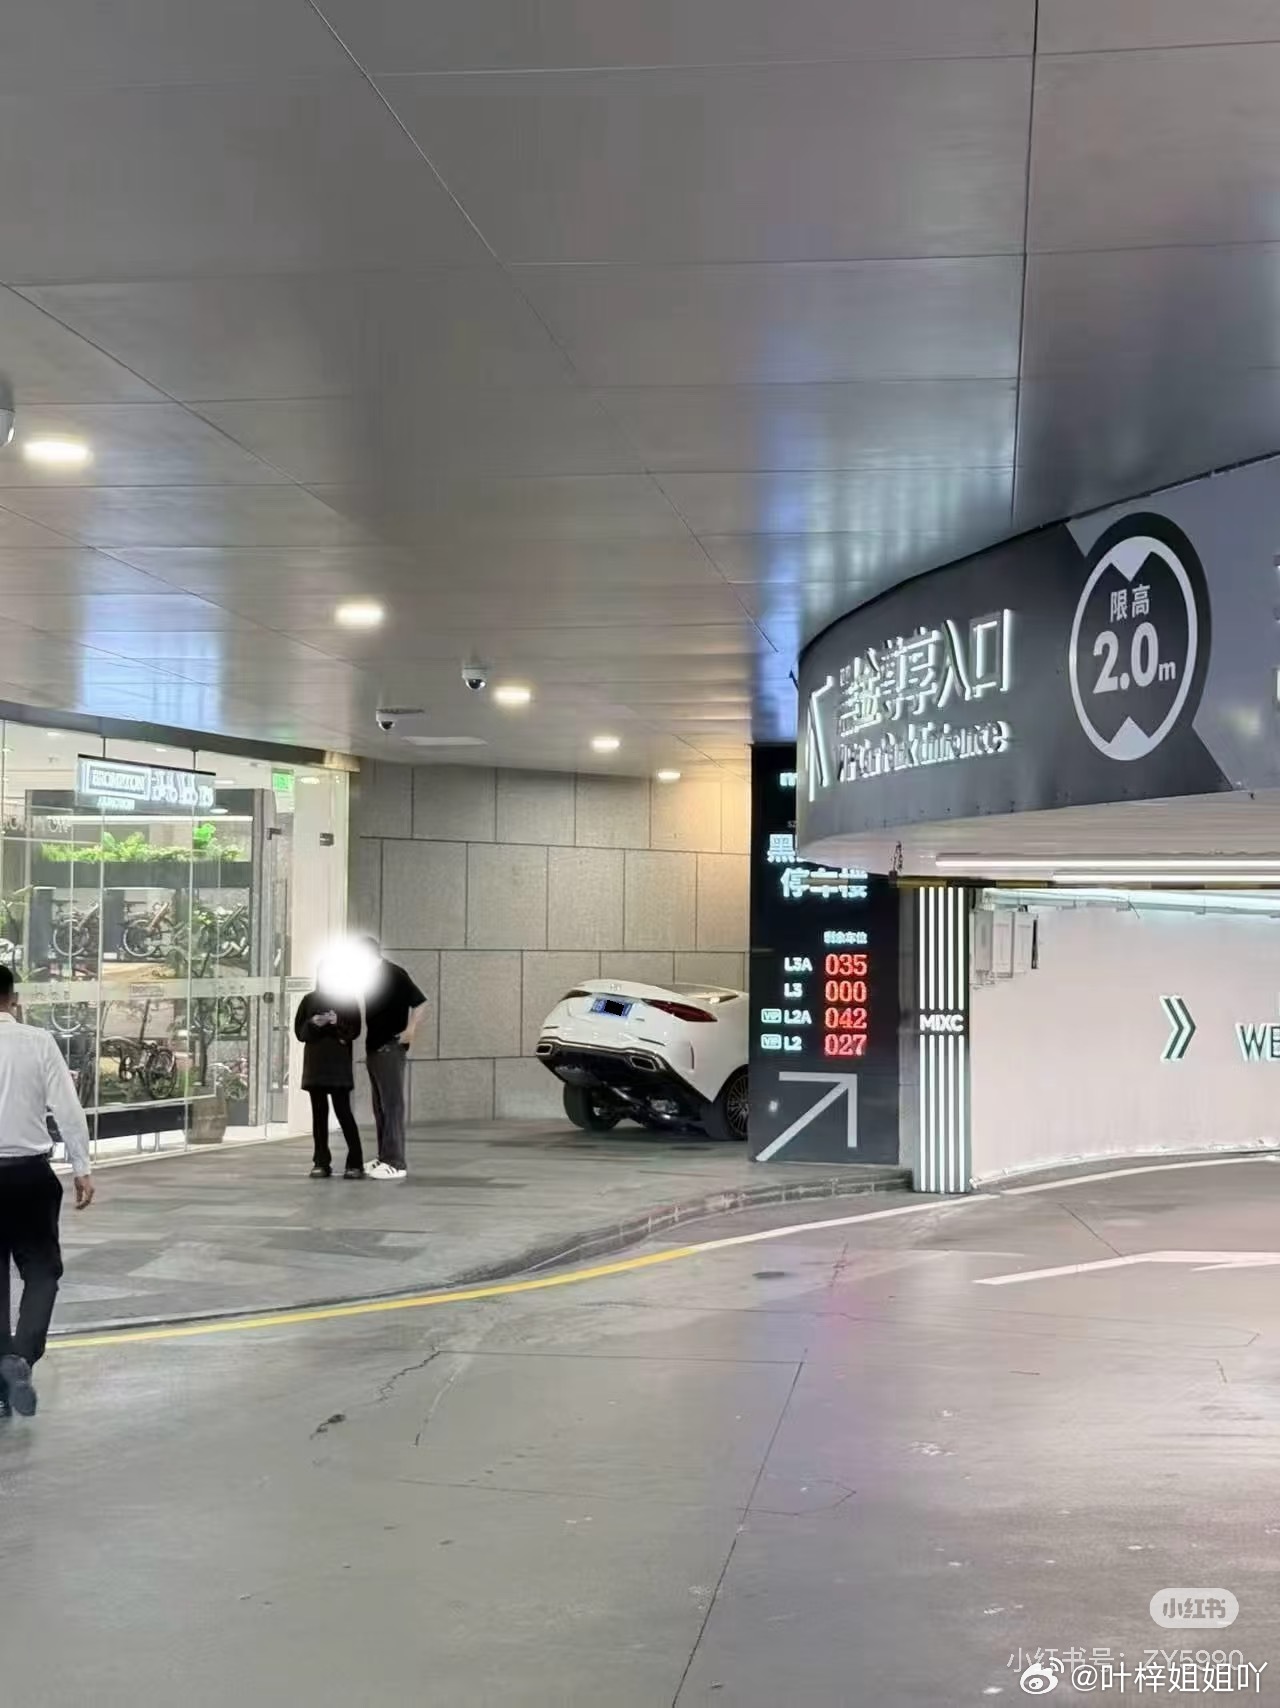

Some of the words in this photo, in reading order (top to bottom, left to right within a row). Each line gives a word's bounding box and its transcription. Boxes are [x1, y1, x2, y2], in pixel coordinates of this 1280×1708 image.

[1110, 584, 1151, 622] 限高
[1093, 622, 1177, 694] 2.0m
[784, 957, 813, 972] L3A
[825, 953, 868, 976] 035
[784, 982, 803, 998] L3
[825, 980, 867, 1003] 000
[783, 1009, 813, 1025] L2A
[825, 1007, 868, 1029] 042
[920, 1014, 964, 1032] MIXC
[783, 1035, 803, 1051] L2
[825, 1033, 868, 1057] 027
